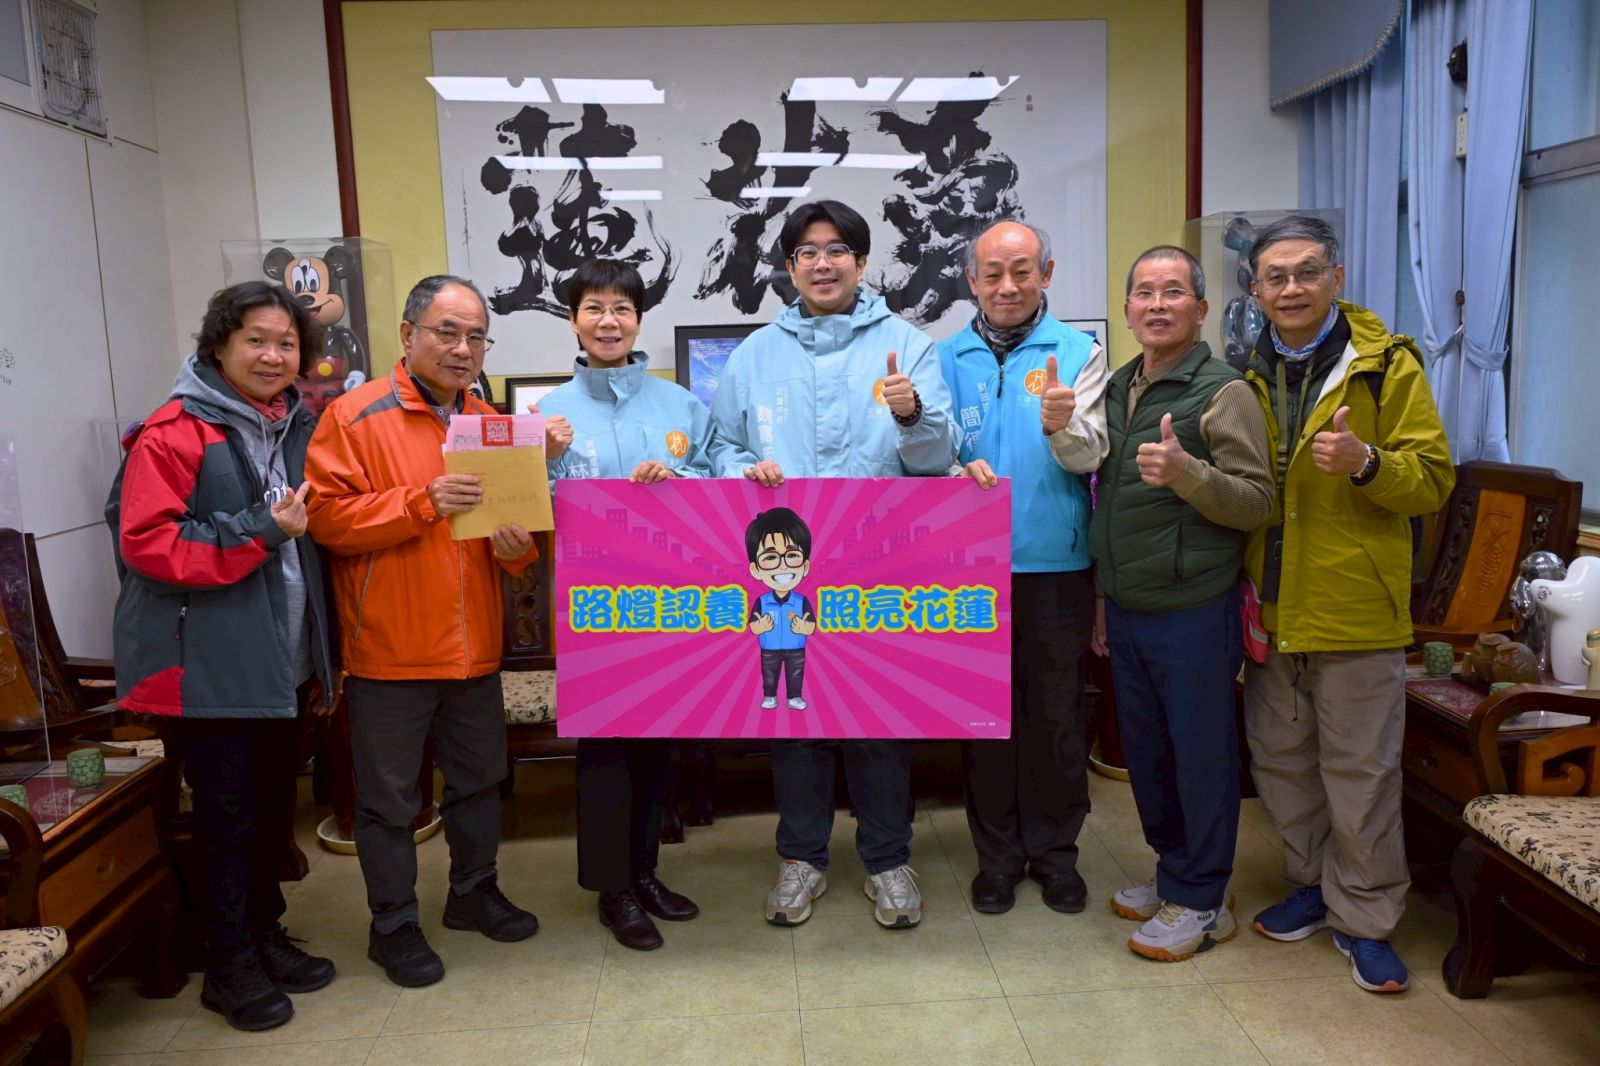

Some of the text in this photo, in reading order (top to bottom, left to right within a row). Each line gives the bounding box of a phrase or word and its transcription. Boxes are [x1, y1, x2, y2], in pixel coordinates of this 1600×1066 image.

[569, 585, 747, 632] 路燈認養
[817, 584, 998, 633] 照亮花蓮
